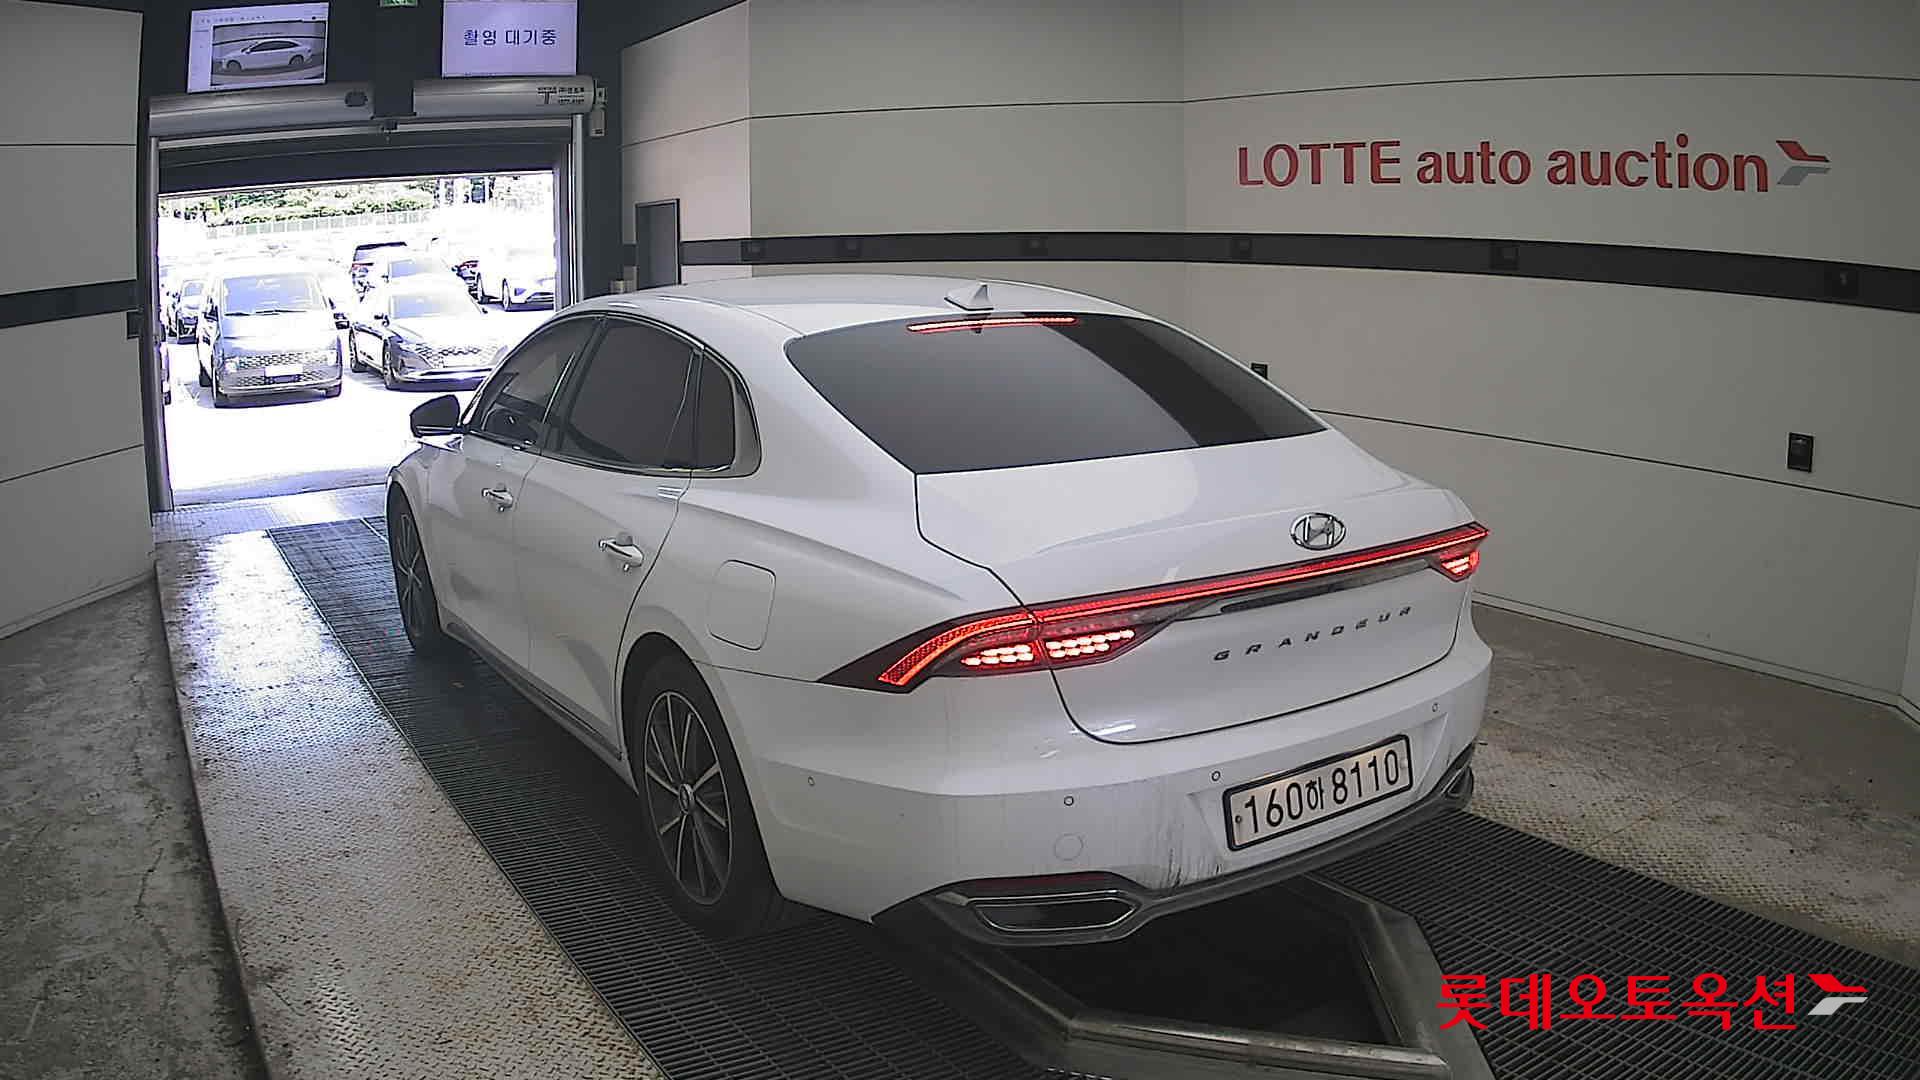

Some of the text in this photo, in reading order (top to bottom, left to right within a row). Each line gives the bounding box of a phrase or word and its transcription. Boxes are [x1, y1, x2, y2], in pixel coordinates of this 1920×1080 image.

[464, 29, 557, 46] 촬영 대기중
[1237, 133, 1769, 193] LOTTE auto auction
[1213, 606, 1412, 661] GRANDEUR
[1244, 749, 1400, 833] 160하 8110
